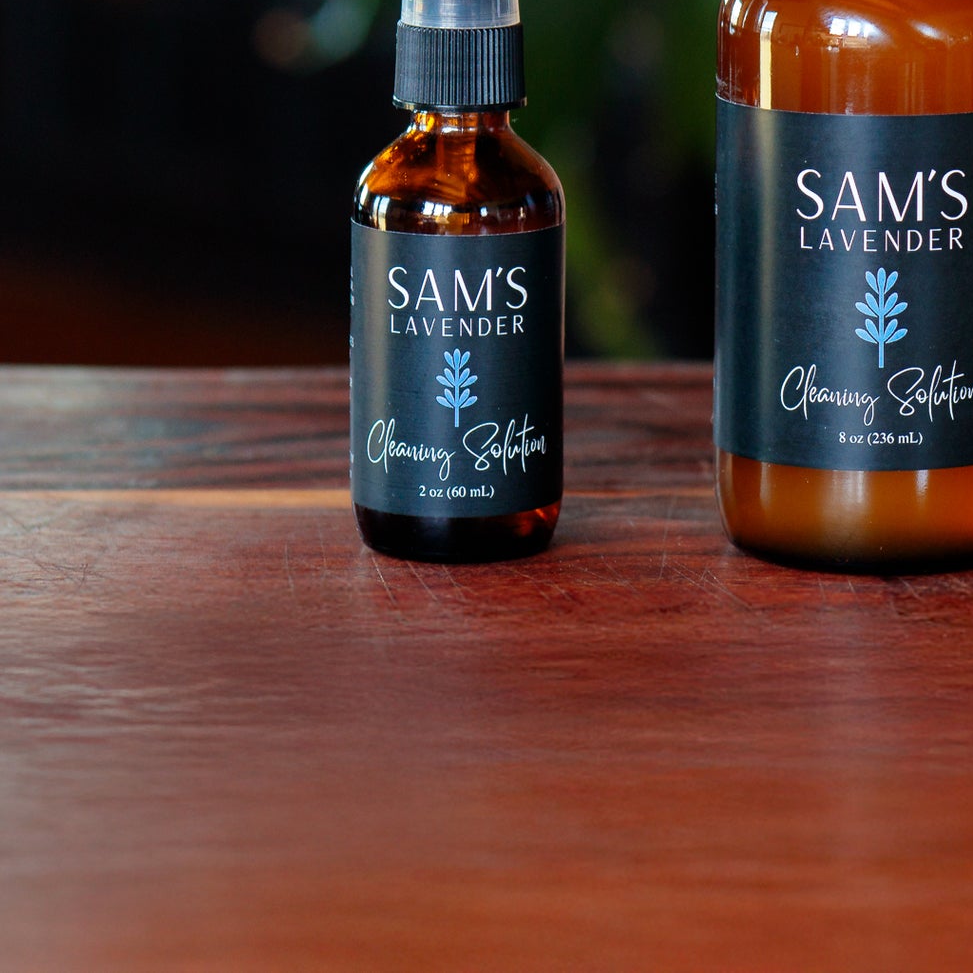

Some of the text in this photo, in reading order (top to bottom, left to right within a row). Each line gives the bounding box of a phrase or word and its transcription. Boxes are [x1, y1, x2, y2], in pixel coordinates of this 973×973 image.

[796, 168, 968, 223] SAM'S
[800, 226, 964, 253] LAVENDER
[386, 265, 530, 313] SAM'S
[390, 313, 524, 337] LAVENDER
[779, 363, 882, 428] Cleaning
[365, 412, 548, 483] Cleaning Solution
[838, 431, 924, 447] 8 oz (236 mL)
[418, 484, 495, 500] 2 oz (60 mL)
